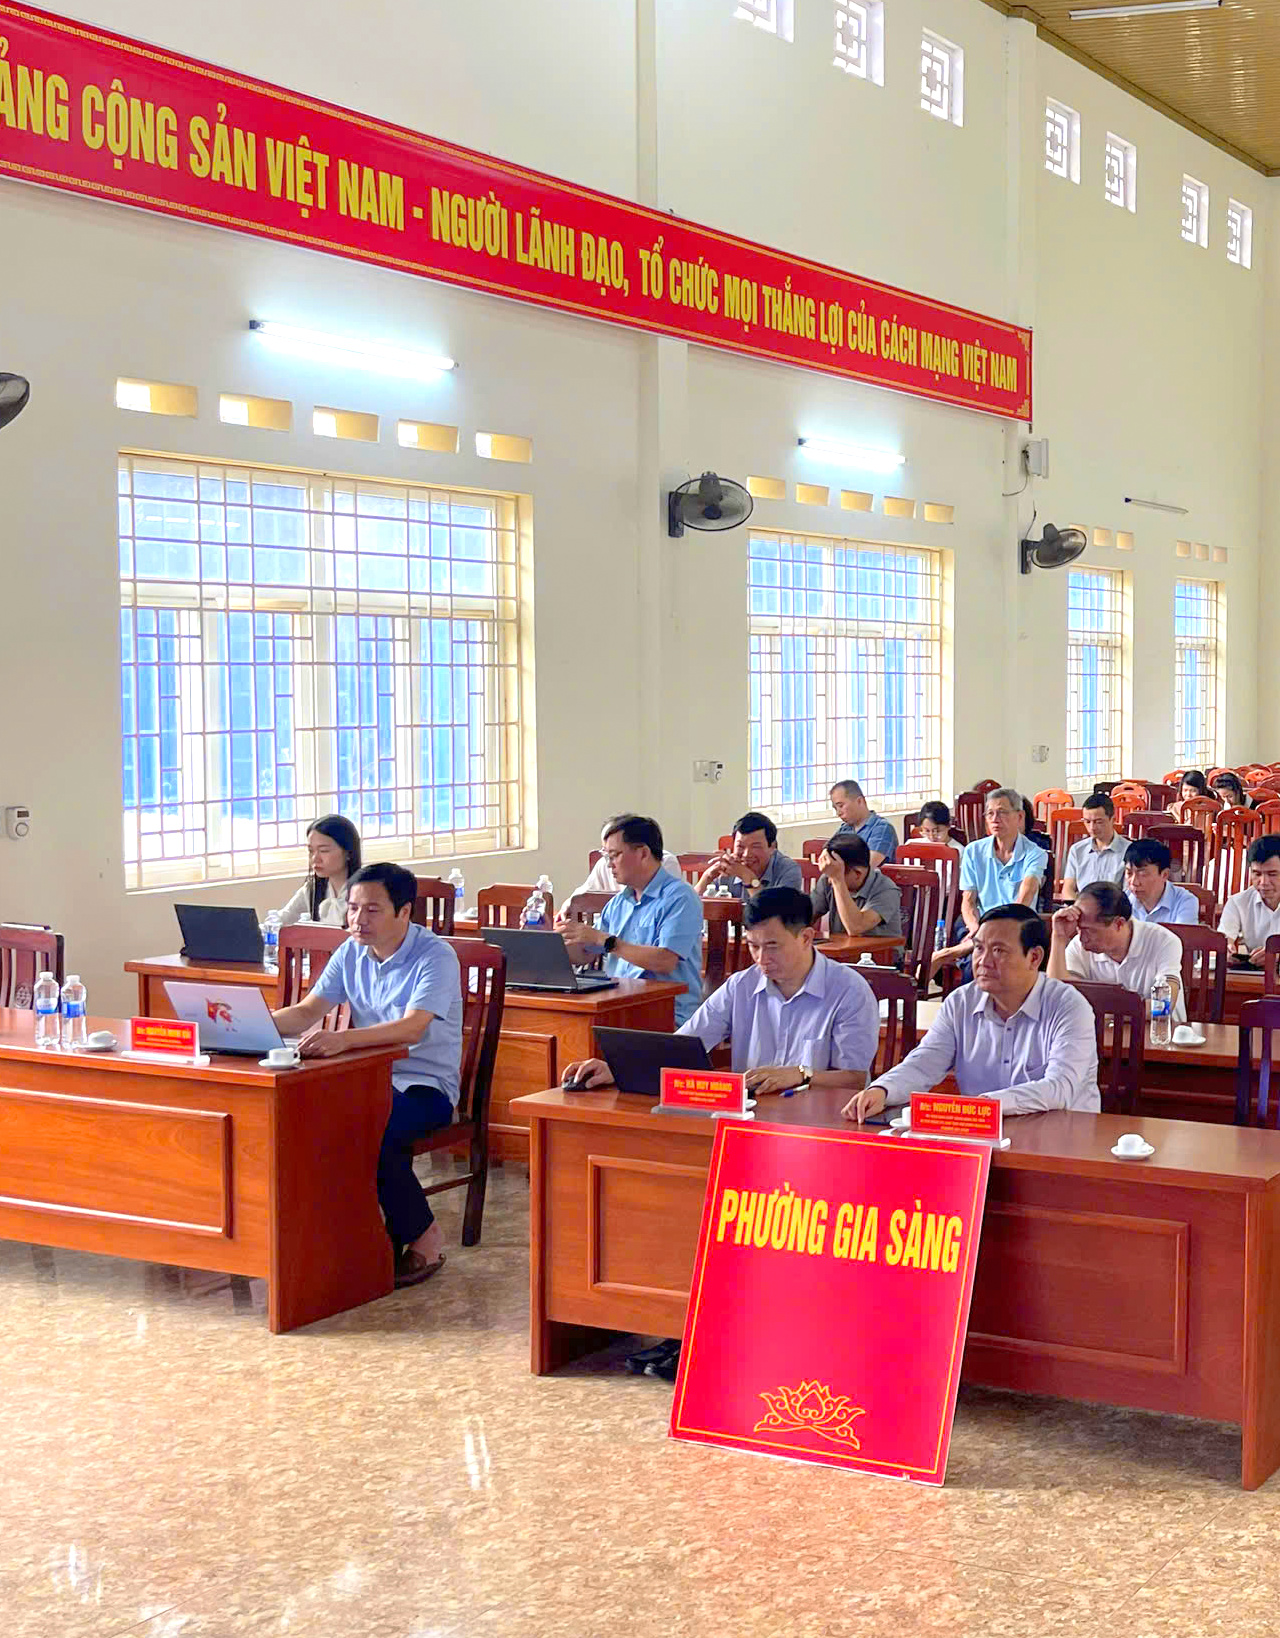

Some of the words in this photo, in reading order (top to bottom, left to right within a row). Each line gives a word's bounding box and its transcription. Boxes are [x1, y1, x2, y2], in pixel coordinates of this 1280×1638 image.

[81, 80, 179, 171] CỘNG
[189, 103, 257, 192] SẢN
[265, 135, 330, 220] VIỆT
[338, 159, 405, 231] NAM
[431, 188, 509, 260] NGƯỜI
[515, 207, 575, 276] LÃNH
[581, 232, 630, 298] ĐẠO,
[638, 236, 665, 300] TỔ
[669, 256, 719, 315] CHỨC
[724, 273, 759, 333] MỌI
[762, 274, 816, 340] THẮNG
[820, 301, 844, 356] LỢI
[847, 300, 878, 356] CỦA
[880, 311, 918, 367] CÁCH
[920, 330, 960, 381] MẠNG
[962, 338, 989, 392] VIỆT
[990, 351, 1019, 393] NAM
[716, 1181, 829, 1256] PHƯỜNG
[832, 1202, 879, 1262] GIA
[885, 1199, 963, 1274] SÀNG
